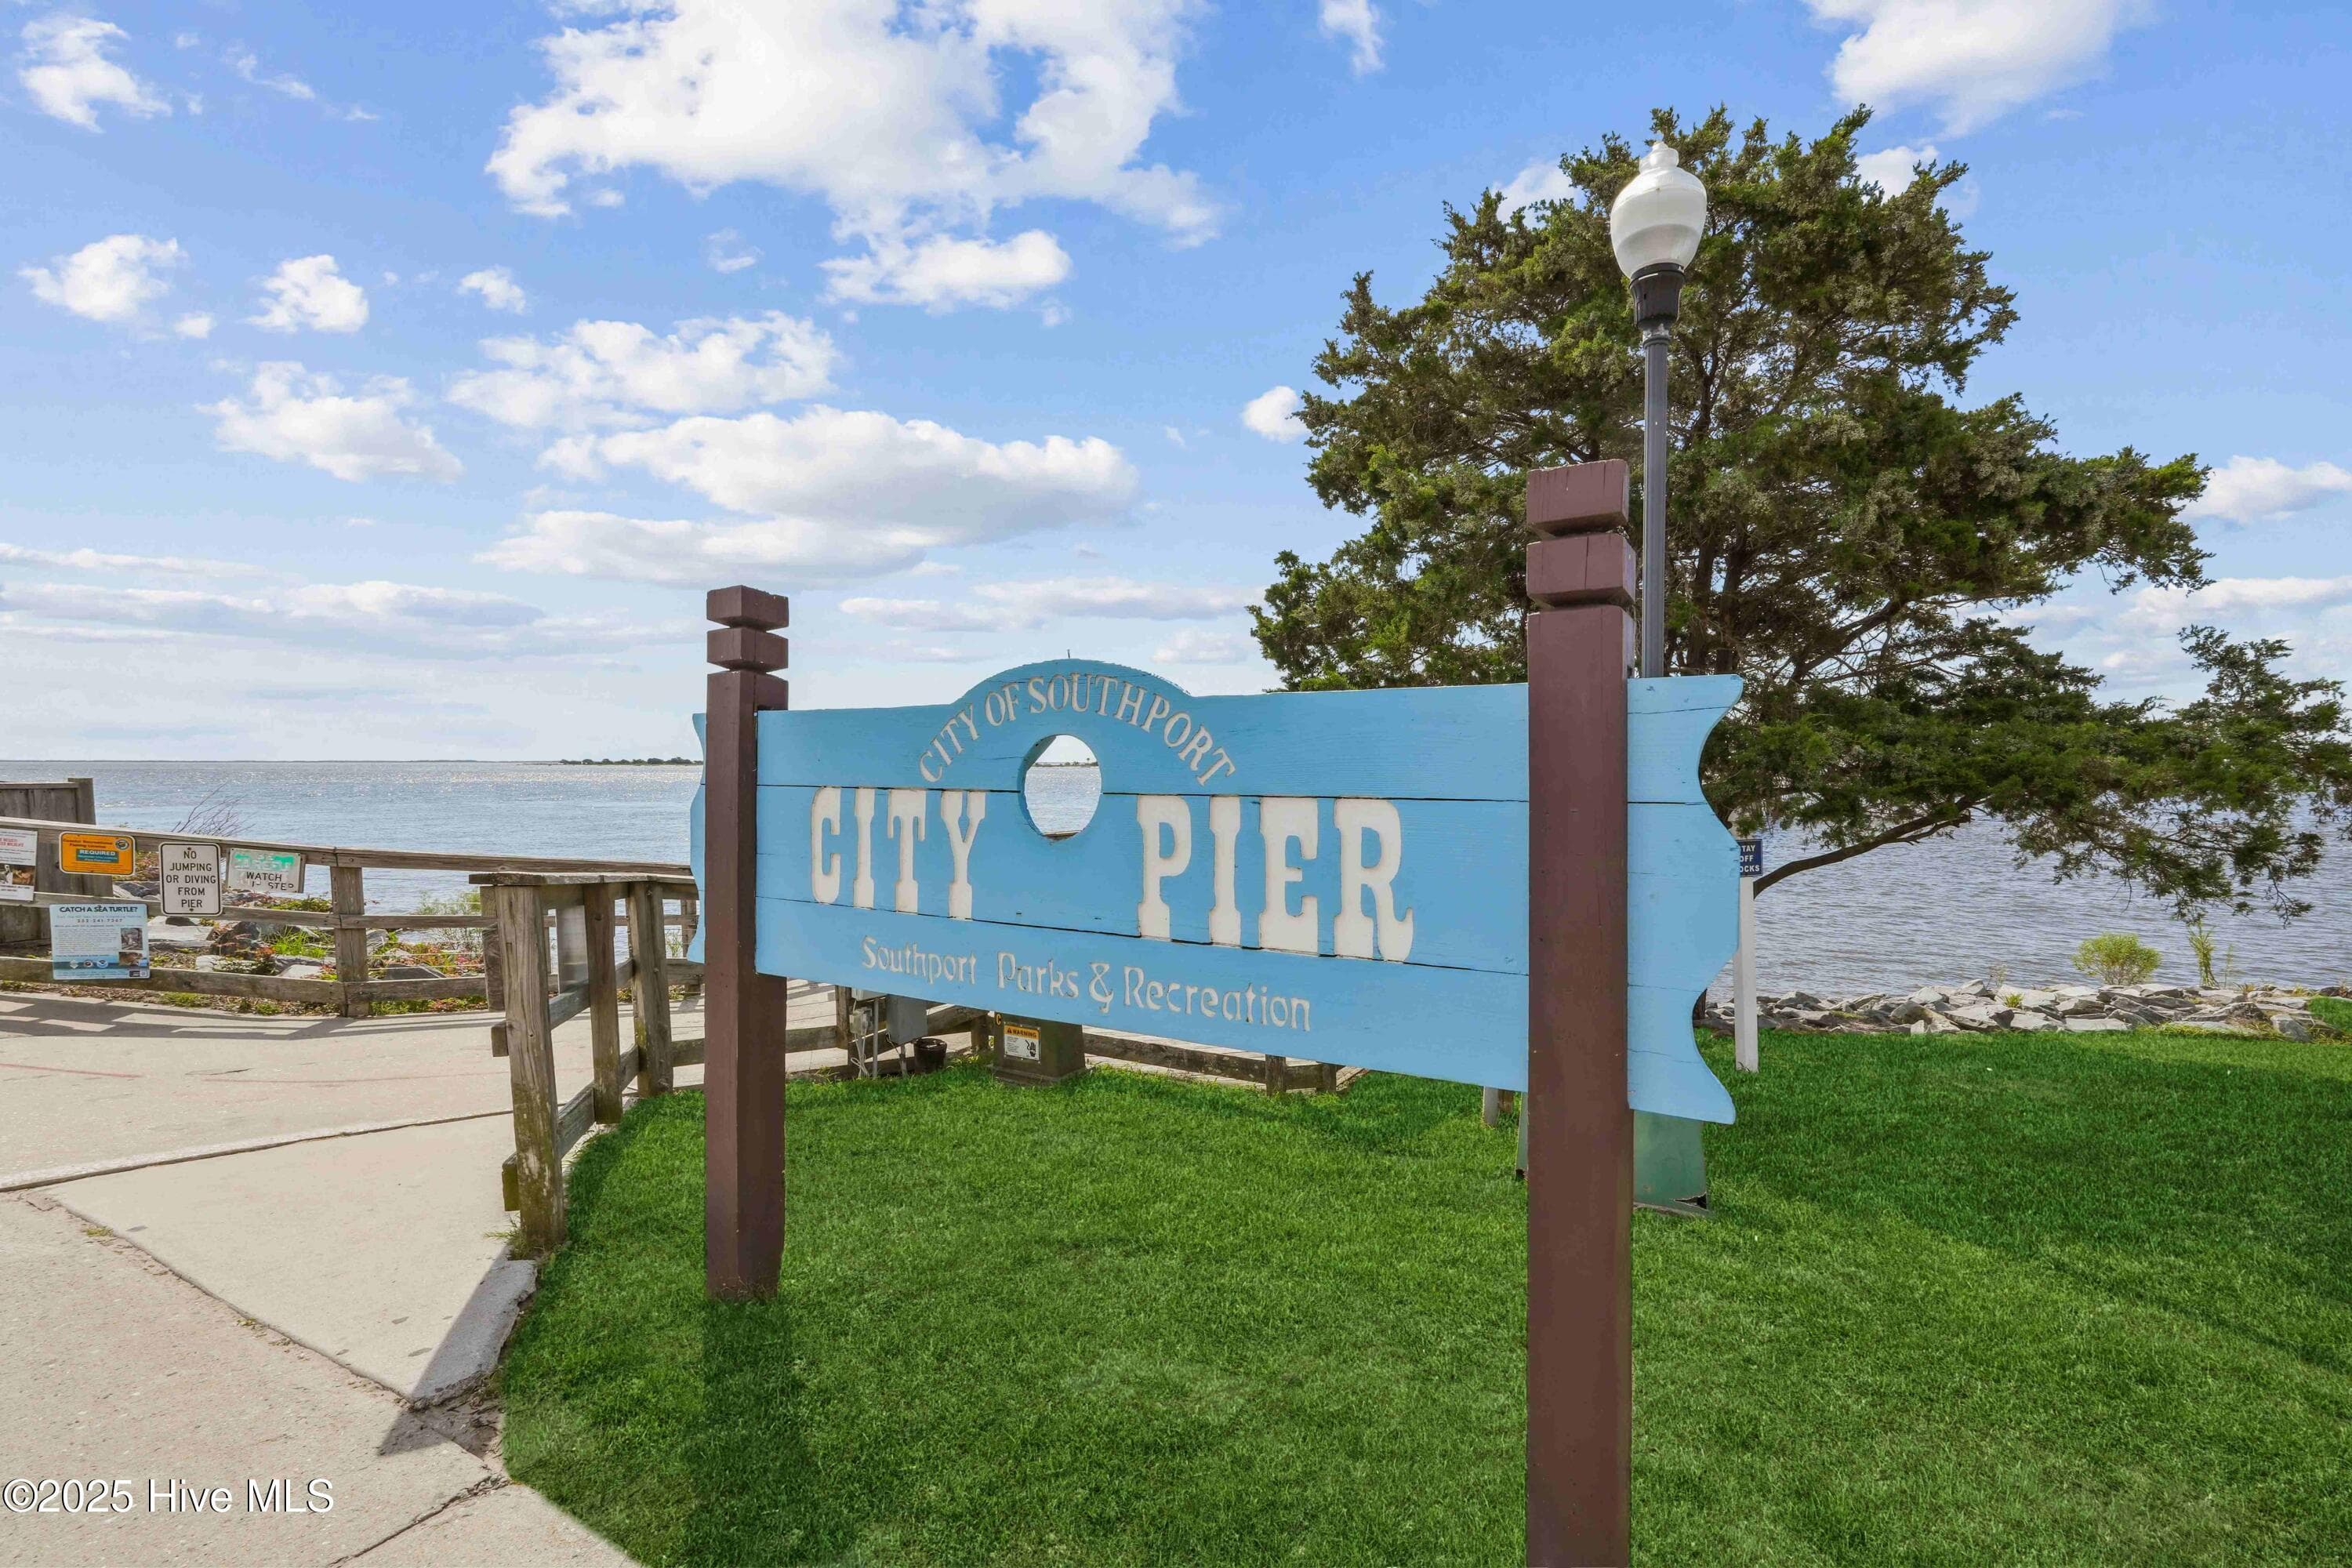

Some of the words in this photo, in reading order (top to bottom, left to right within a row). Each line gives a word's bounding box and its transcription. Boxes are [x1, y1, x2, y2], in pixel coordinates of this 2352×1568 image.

[920, 704, 979, 782] CITY
[985, 682, 1020, 727] OF
[1027, 672, 1236, 786] SOUTHPORT
[183, 851, 197, 859] NO
[169, 862, 212, 872] JUMPING
[246, 871, 282, 882] WATCH
[811, 786, 987, 920] CITY
[1137, 795, 1414, 962] PIER
[165, 875, 179, 884] OR
[185, 875, 216, 884] DIVING
[178, 887, 205, 895] FROM
[268, 882, 294, 891] STEP
[181, 899, 202, 908] PIER
[862, 935, 977, 985] Southport
[997, 951, 1079, 998] Parks
[1088, 962, 1113, 1013] &
[1123, 965, 1310, 1031] Recreation
[1013, 1029, 1037, 1038] WARNING
